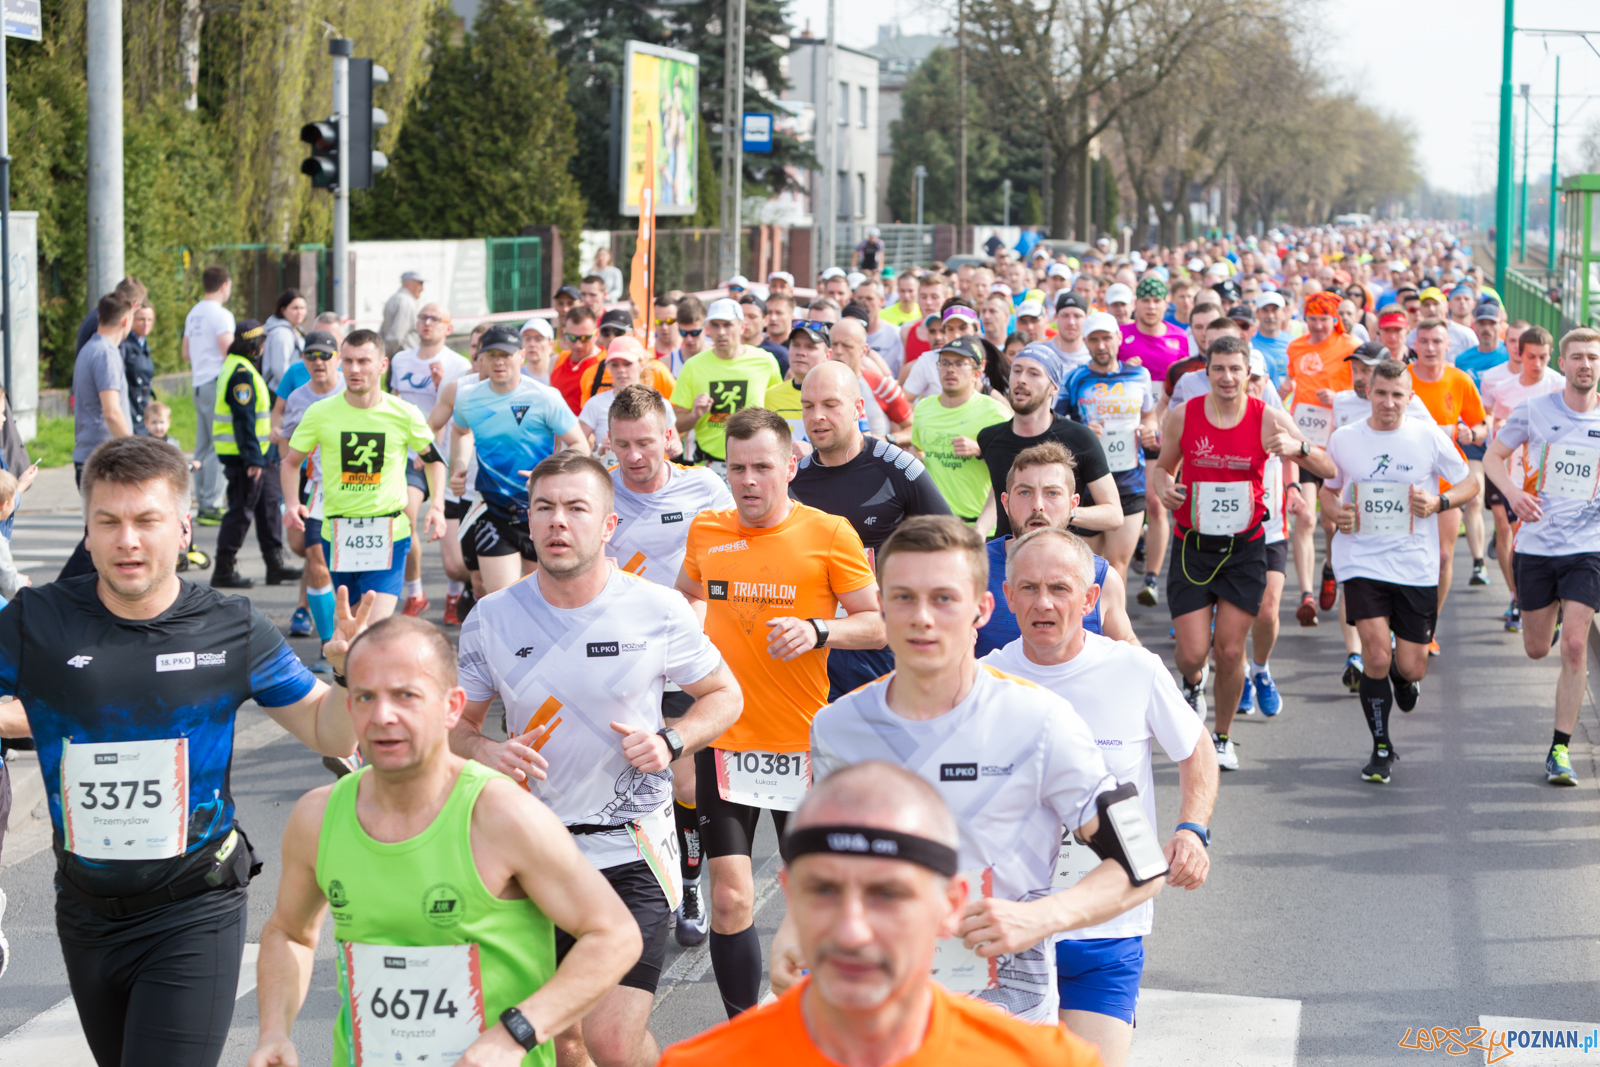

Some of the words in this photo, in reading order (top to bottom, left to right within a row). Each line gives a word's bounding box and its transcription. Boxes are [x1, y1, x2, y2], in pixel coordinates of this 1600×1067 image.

[1094, 382, 1125, 397] 34
[1298, 416, 1327, 430] 6399
[1108, 441, 1125, 453] 60
[1555, 461, 1591, 478] 9018
[1211, 499, 1240, 513] 255
[1364, 500, 1404, 513] 8594
[863, 516, 877, 526] 4F
[345, 535, 383, 548] 4833
[707, 540, 749, 555] FINISHER
[711, 585, 724, 595] JBL
[733, 581, 797, 600] TRIATHLON
[515, 647, 534, 658] 4F
[67, 655, 94, 668] 4F
[732, 751, 801, 777] 10381
[79, 779, 162, 811] 3375
[370, 987, 458, 1020] 6674
[390, 1028, 436, 1039] Krzysztof
